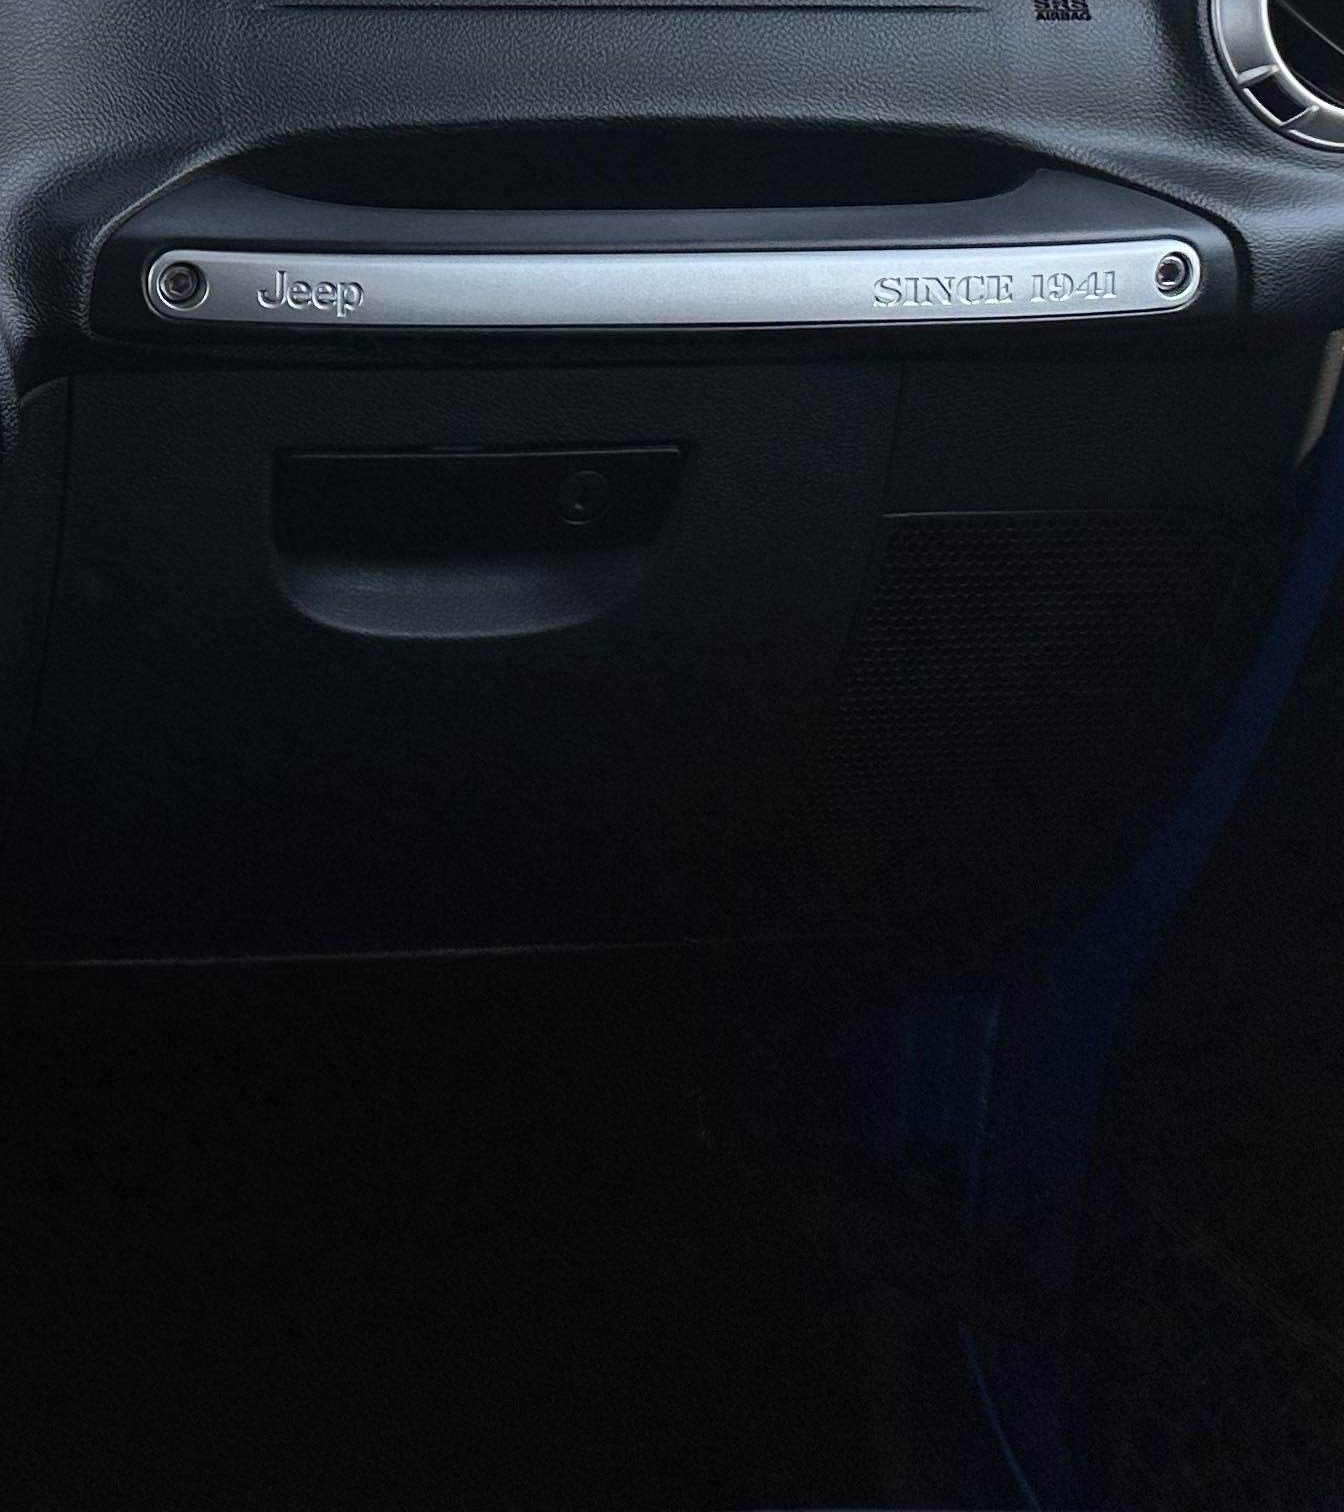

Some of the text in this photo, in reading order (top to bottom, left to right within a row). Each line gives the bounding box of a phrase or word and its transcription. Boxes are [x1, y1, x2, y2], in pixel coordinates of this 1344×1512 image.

[256, 270, 367, 317] Jeep
[871, 268, 1117, 309] SINCE 1941
